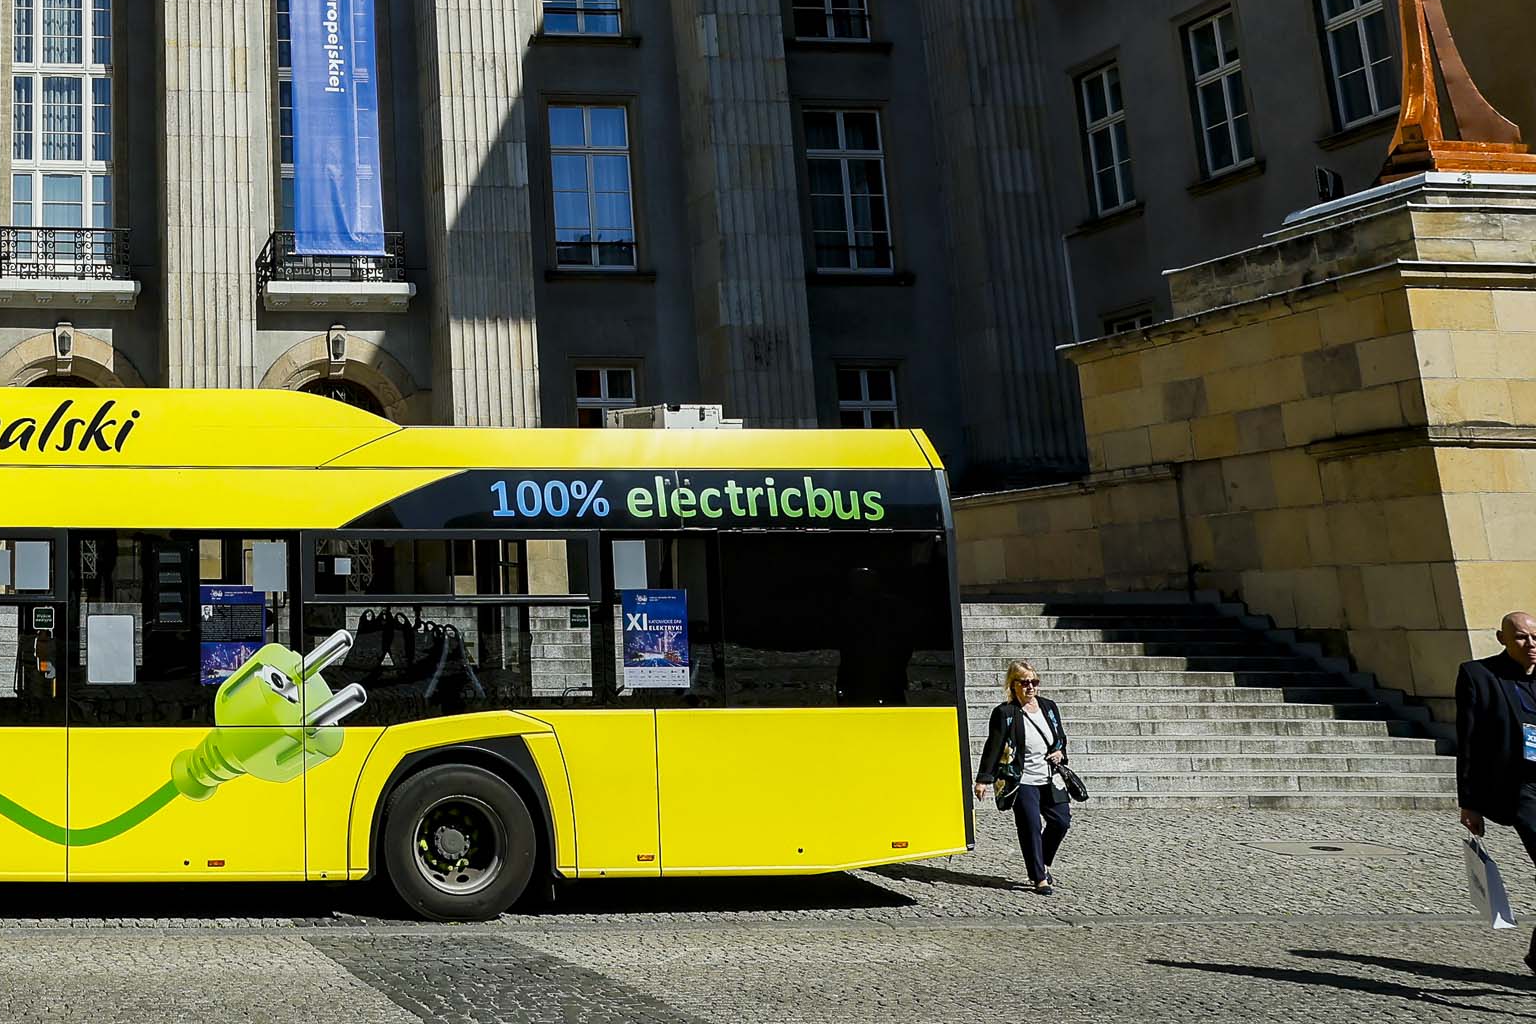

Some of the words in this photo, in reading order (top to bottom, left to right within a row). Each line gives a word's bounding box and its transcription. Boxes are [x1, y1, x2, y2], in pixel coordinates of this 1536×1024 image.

[490, 479, 610, 518] 100%
[626, 476, 885, 521] electricbus
[626, 613, 648, 631] XI
